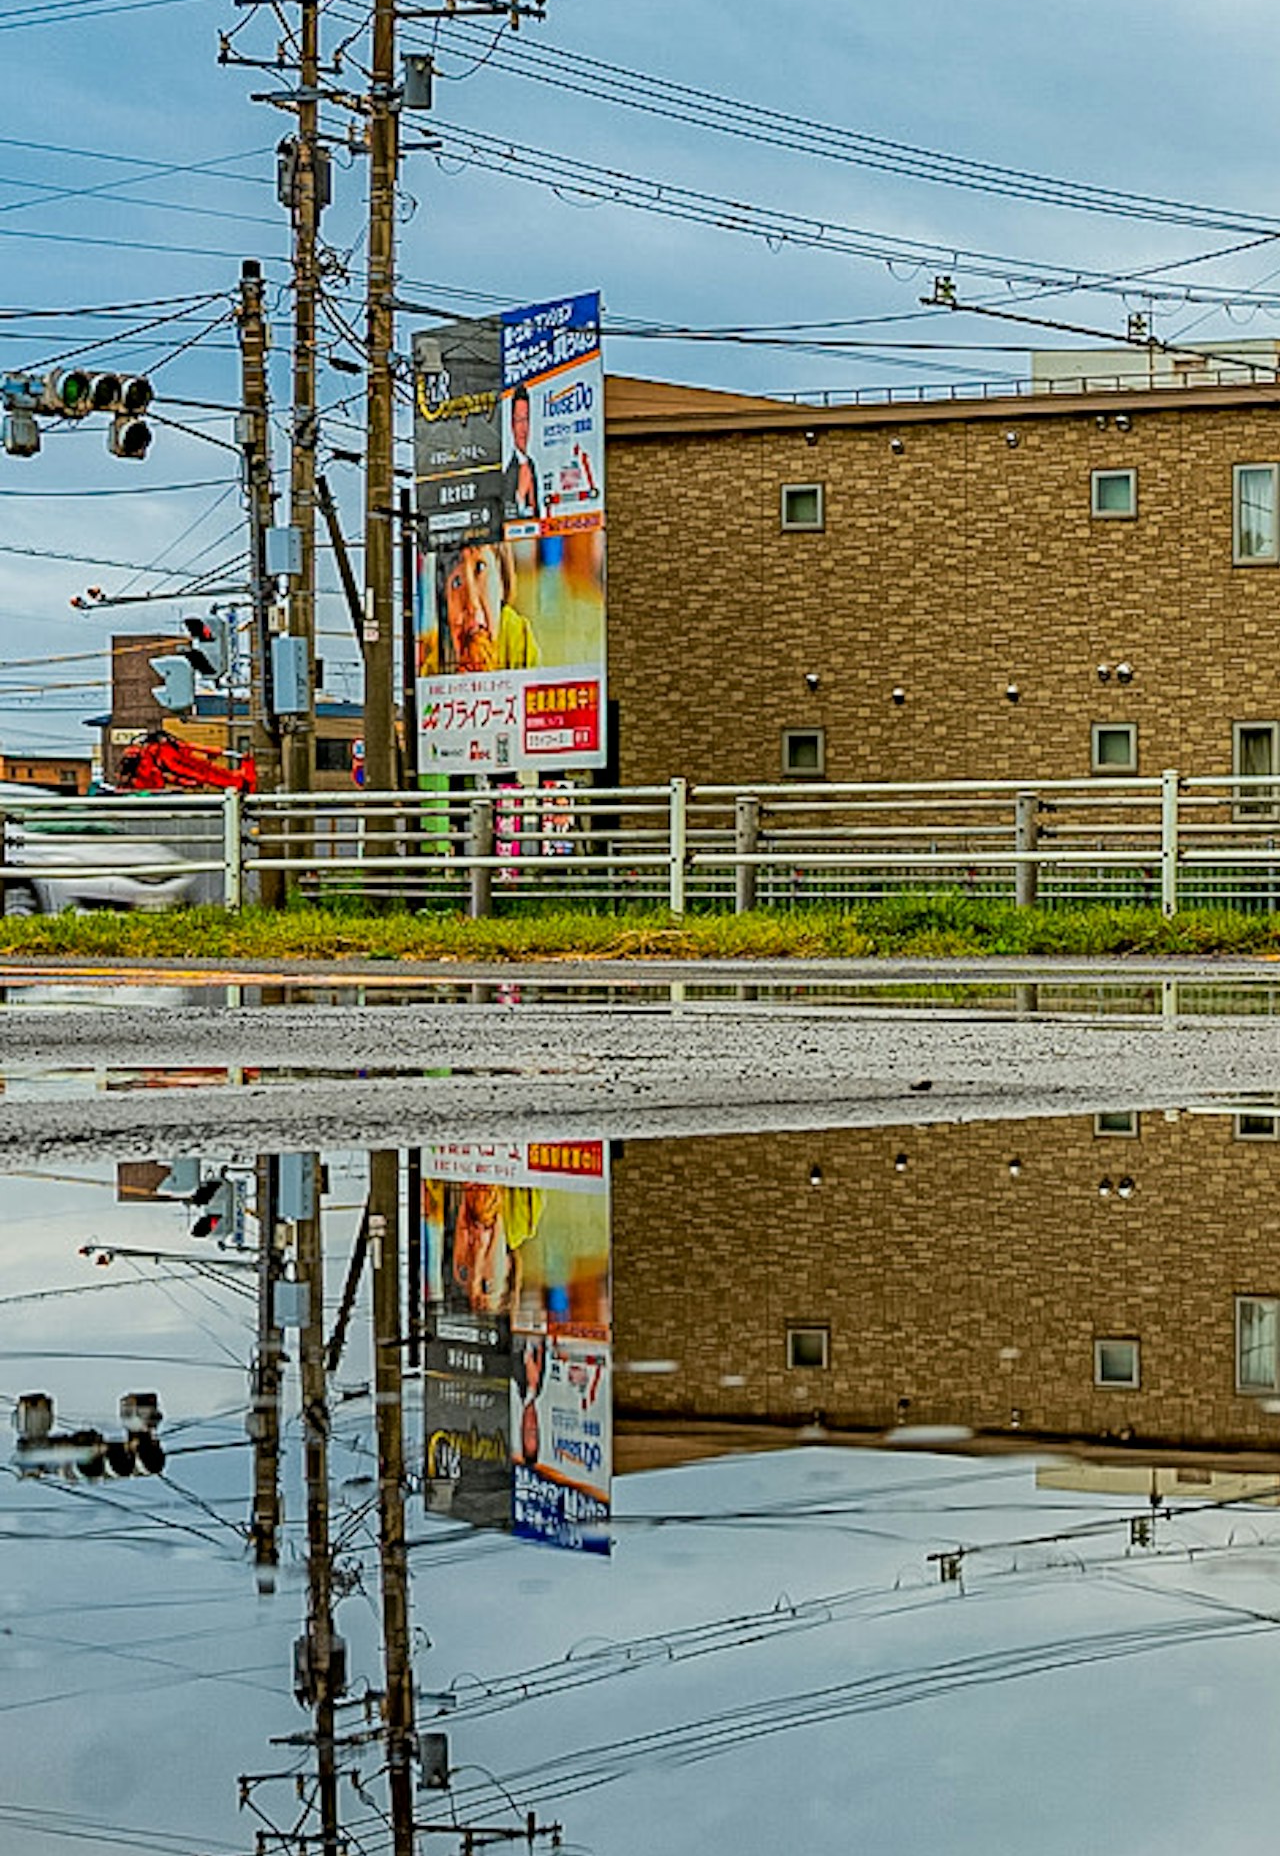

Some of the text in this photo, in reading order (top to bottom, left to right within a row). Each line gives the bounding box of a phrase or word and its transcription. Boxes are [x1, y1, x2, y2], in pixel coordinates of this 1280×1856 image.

[443, 696, 518, 730] プライフーズ
